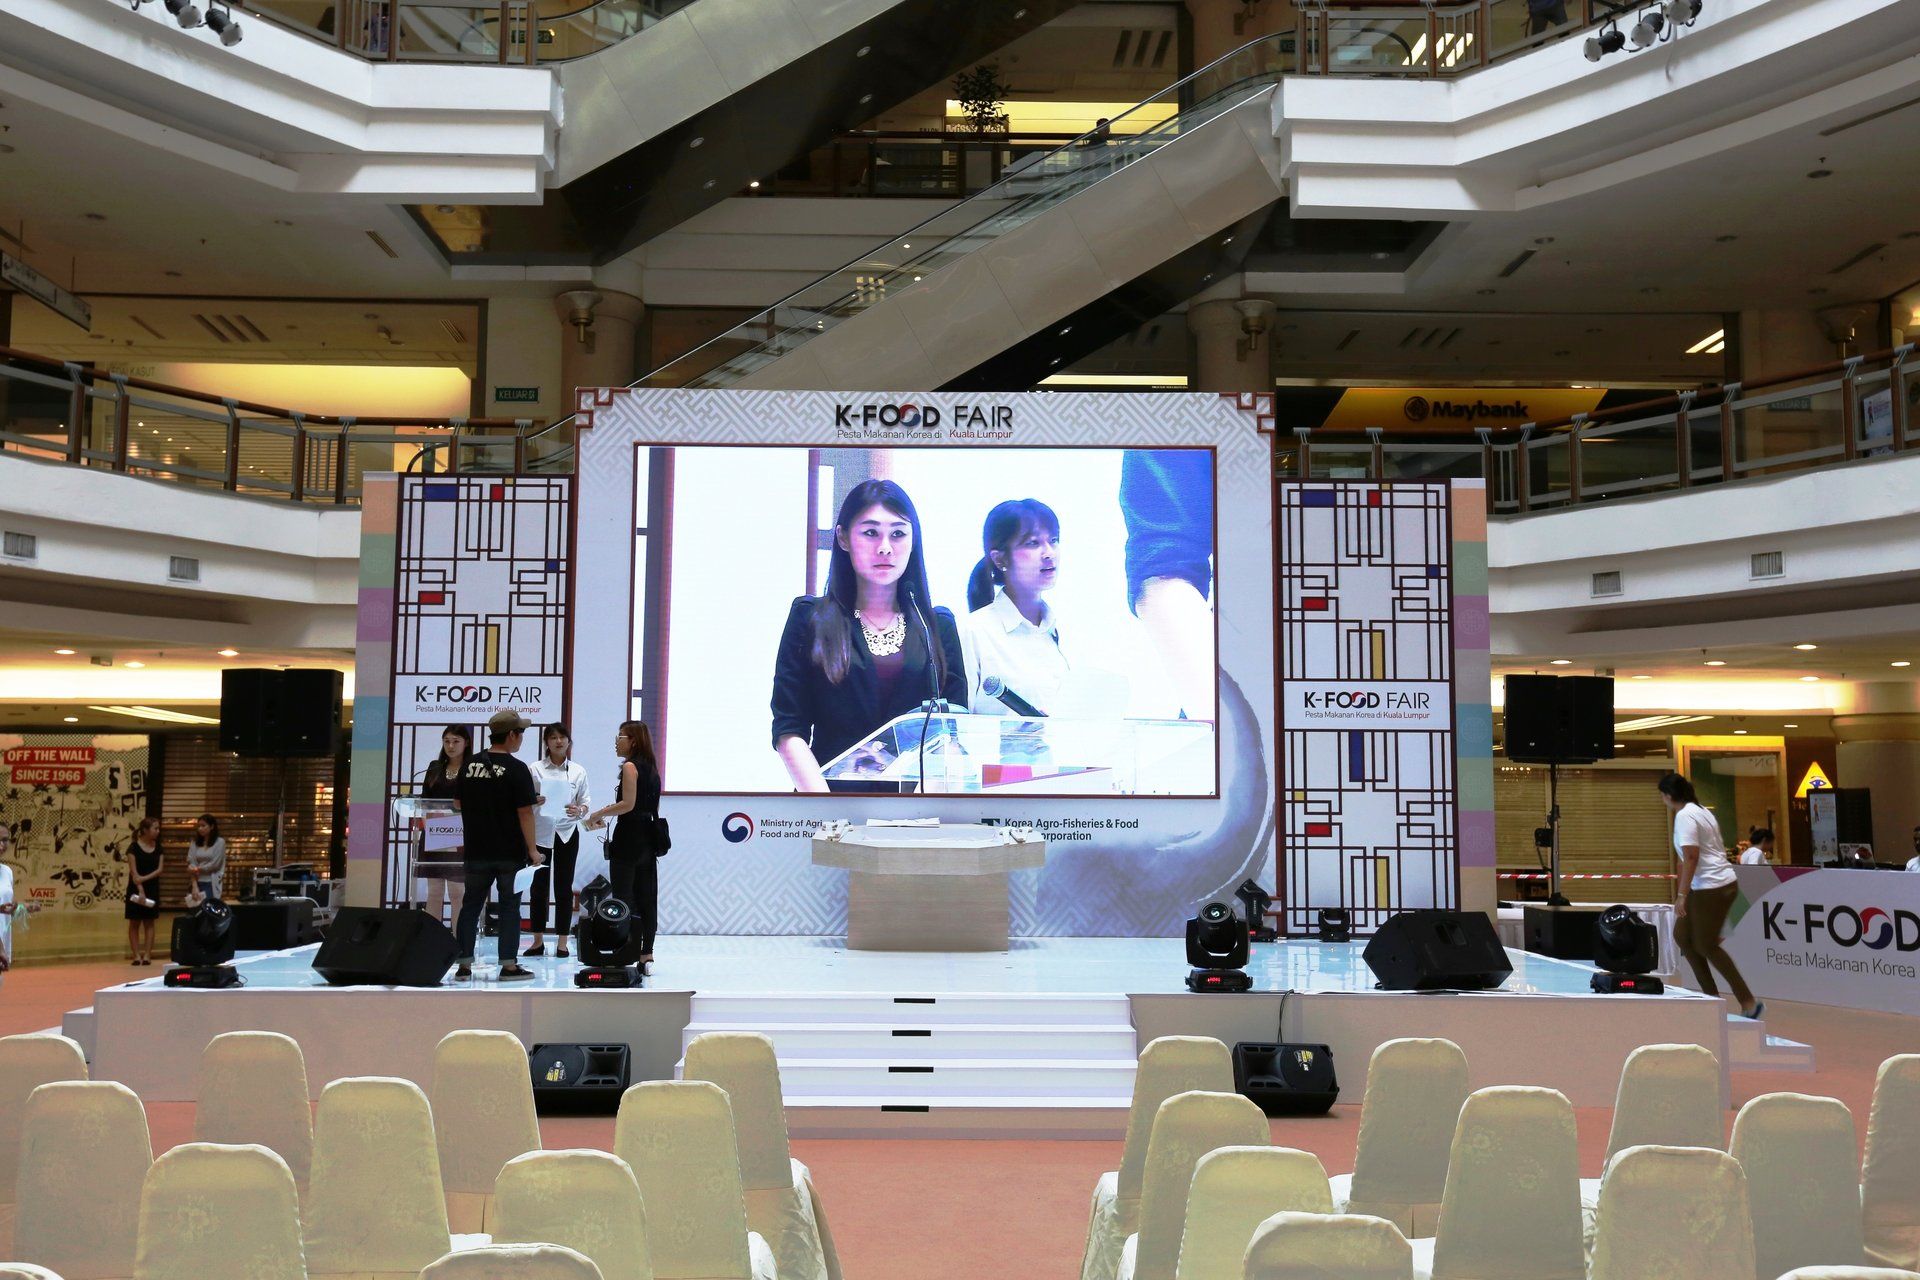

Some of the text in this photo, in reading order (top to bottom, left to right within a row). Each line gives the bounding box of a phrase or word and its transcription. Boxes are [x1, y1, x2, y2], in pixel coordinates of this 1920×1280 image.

[1432, 400, 1529, 421] Maybank
[954, 405, 1013, 428] FAIR
[837, 430, 1013, 440] Pesta Makanan Korea di Kuala Lumpur
[498, 686, 542, 703] FAIR
[1386, 692, 1430, 709] FAIR
[415, 705, 434, 713] Pesta
[435, 705, 466, 713] Makanan
[467, 705, 486, 713] Korea
[487, 705, 494, 713] di
[515, 706, 541, 714] Lumpur
[1305, 711, 1430, 720] Pesta Makanan Korea di Kuala Lumpur
[7, 750, 91, 761] OFF THE WALL
[16, 770, 81, 781] SINCE 1966
[760, 819, 792, 829] Ministry
[795, 819, 804, 827] of
[1005, 818, 1139, 831] Korea Agro-Fisheries & Food
[29, 887, 57, 898] VANS
[1766, 948, 1916, 978] Pesta Makanan Korea
